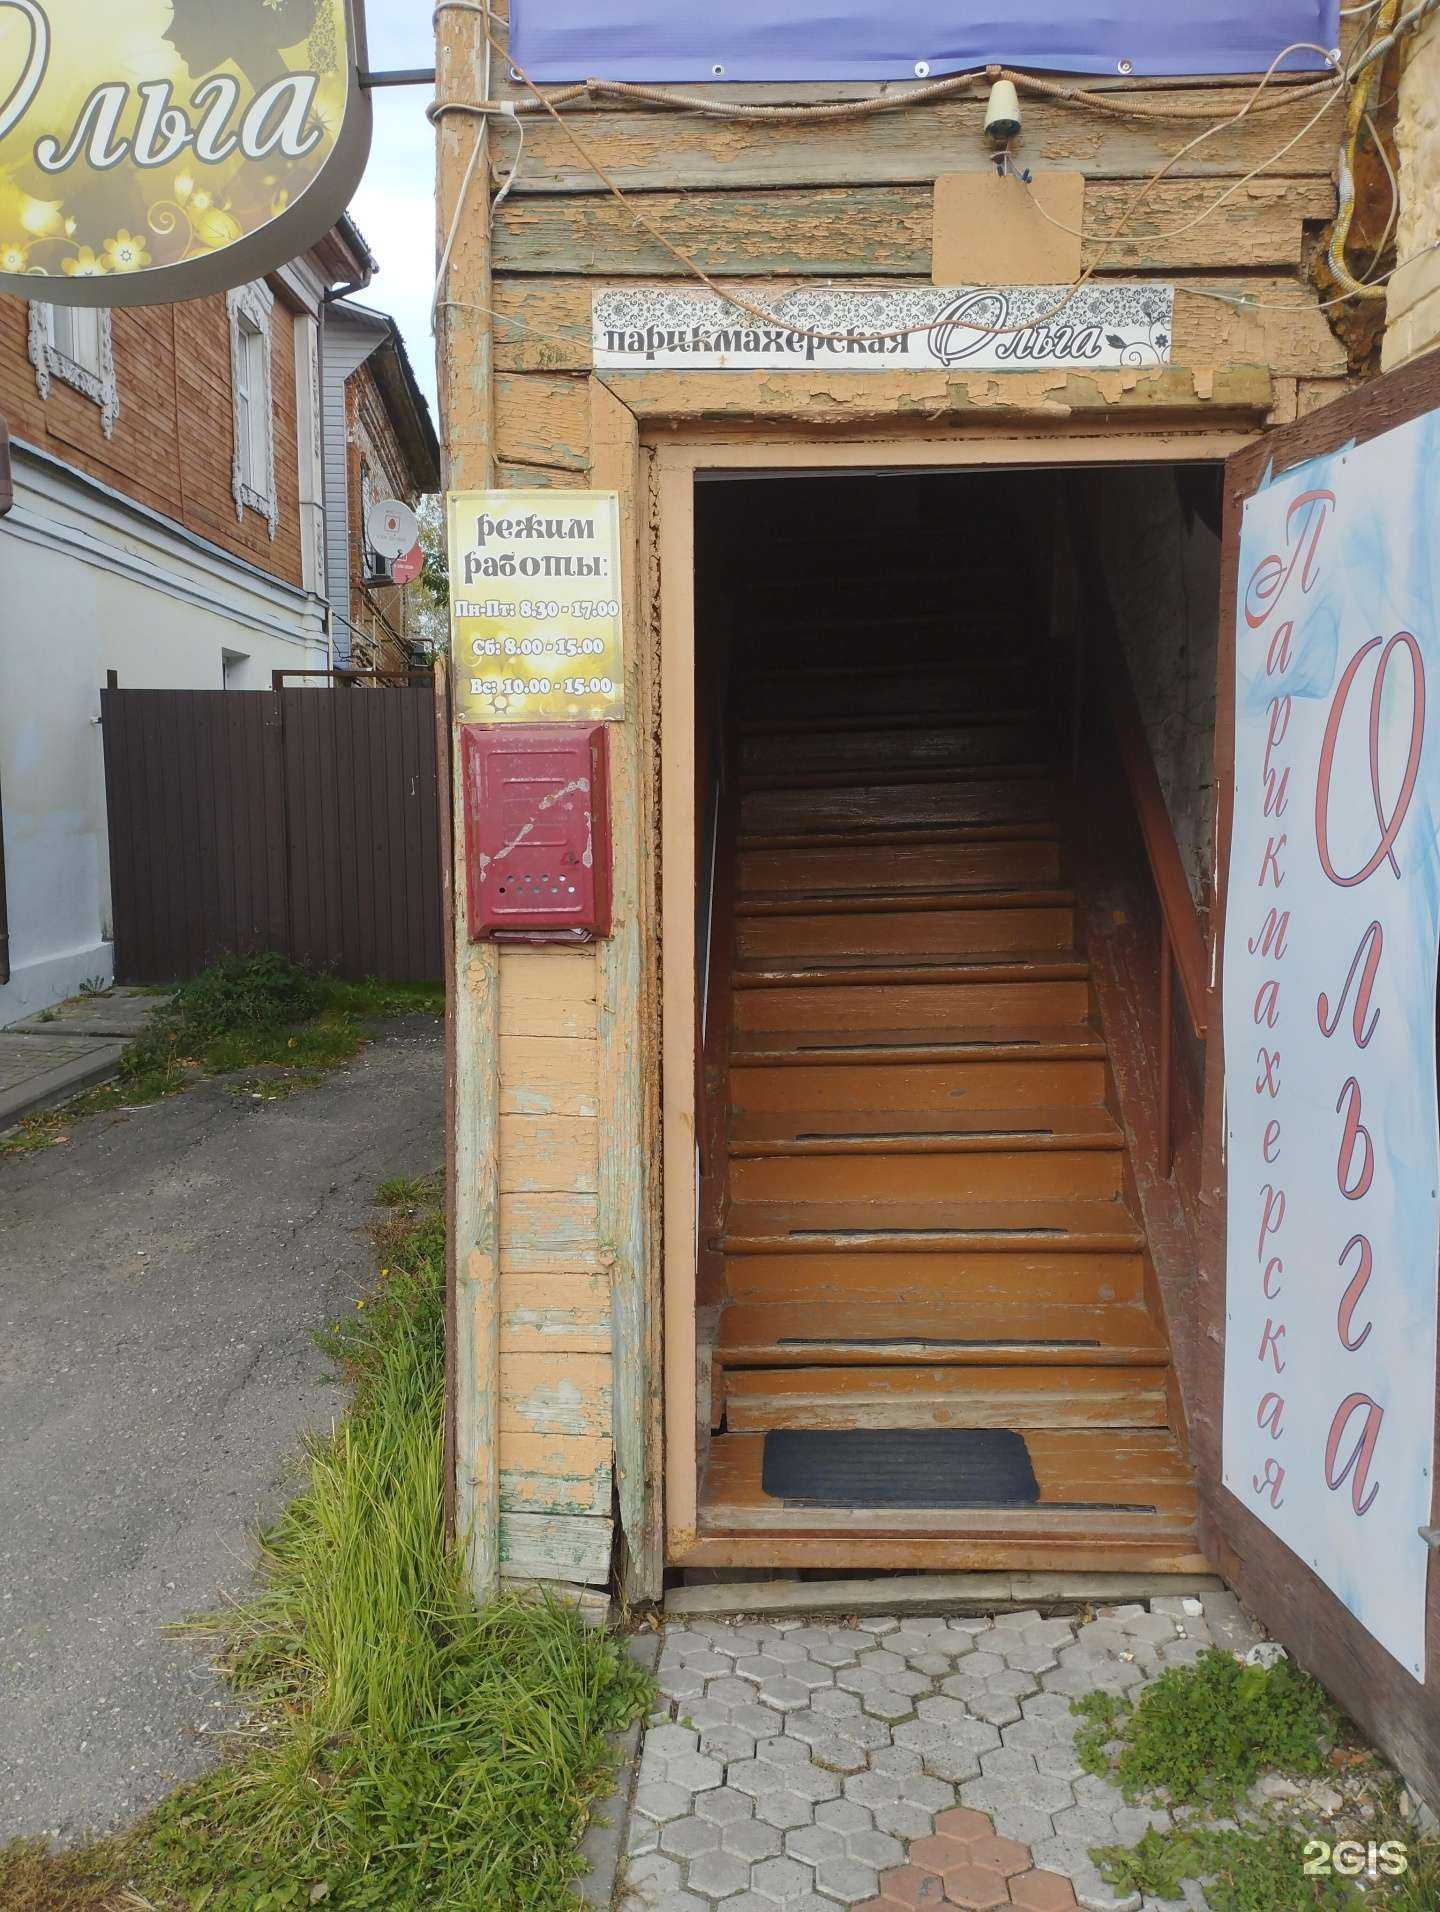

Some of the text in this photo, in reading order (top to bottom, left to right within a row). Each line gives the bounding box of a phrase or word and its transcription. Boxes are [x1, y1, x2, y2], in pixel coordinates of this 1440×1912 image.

[0, 0, 323, 174] льга
[603, 288, 1103, 366] парикмахерская Ольга
[477, 513, 594, 546] режим
[464, 551, 608, 584] работы:
[454, 600, 516, 618] Пн-Пт:
[519, 600, 559, 619] 8.30
[571, 600, 618, 619] 17.00
[472, 639, 501, 656] Сб:
[504, 638, 543, 656] 8.00
[555, 638, 604, 656] 15.00
[470, 678, 498, 695] Вс:
[503, 678, 550, 695] 10.00
[564, 678, 613, 695] 15.00
[1245, 488, 1337, 1509] Парикмахерская
[1315, 631, 1426, 1515] Ольга
